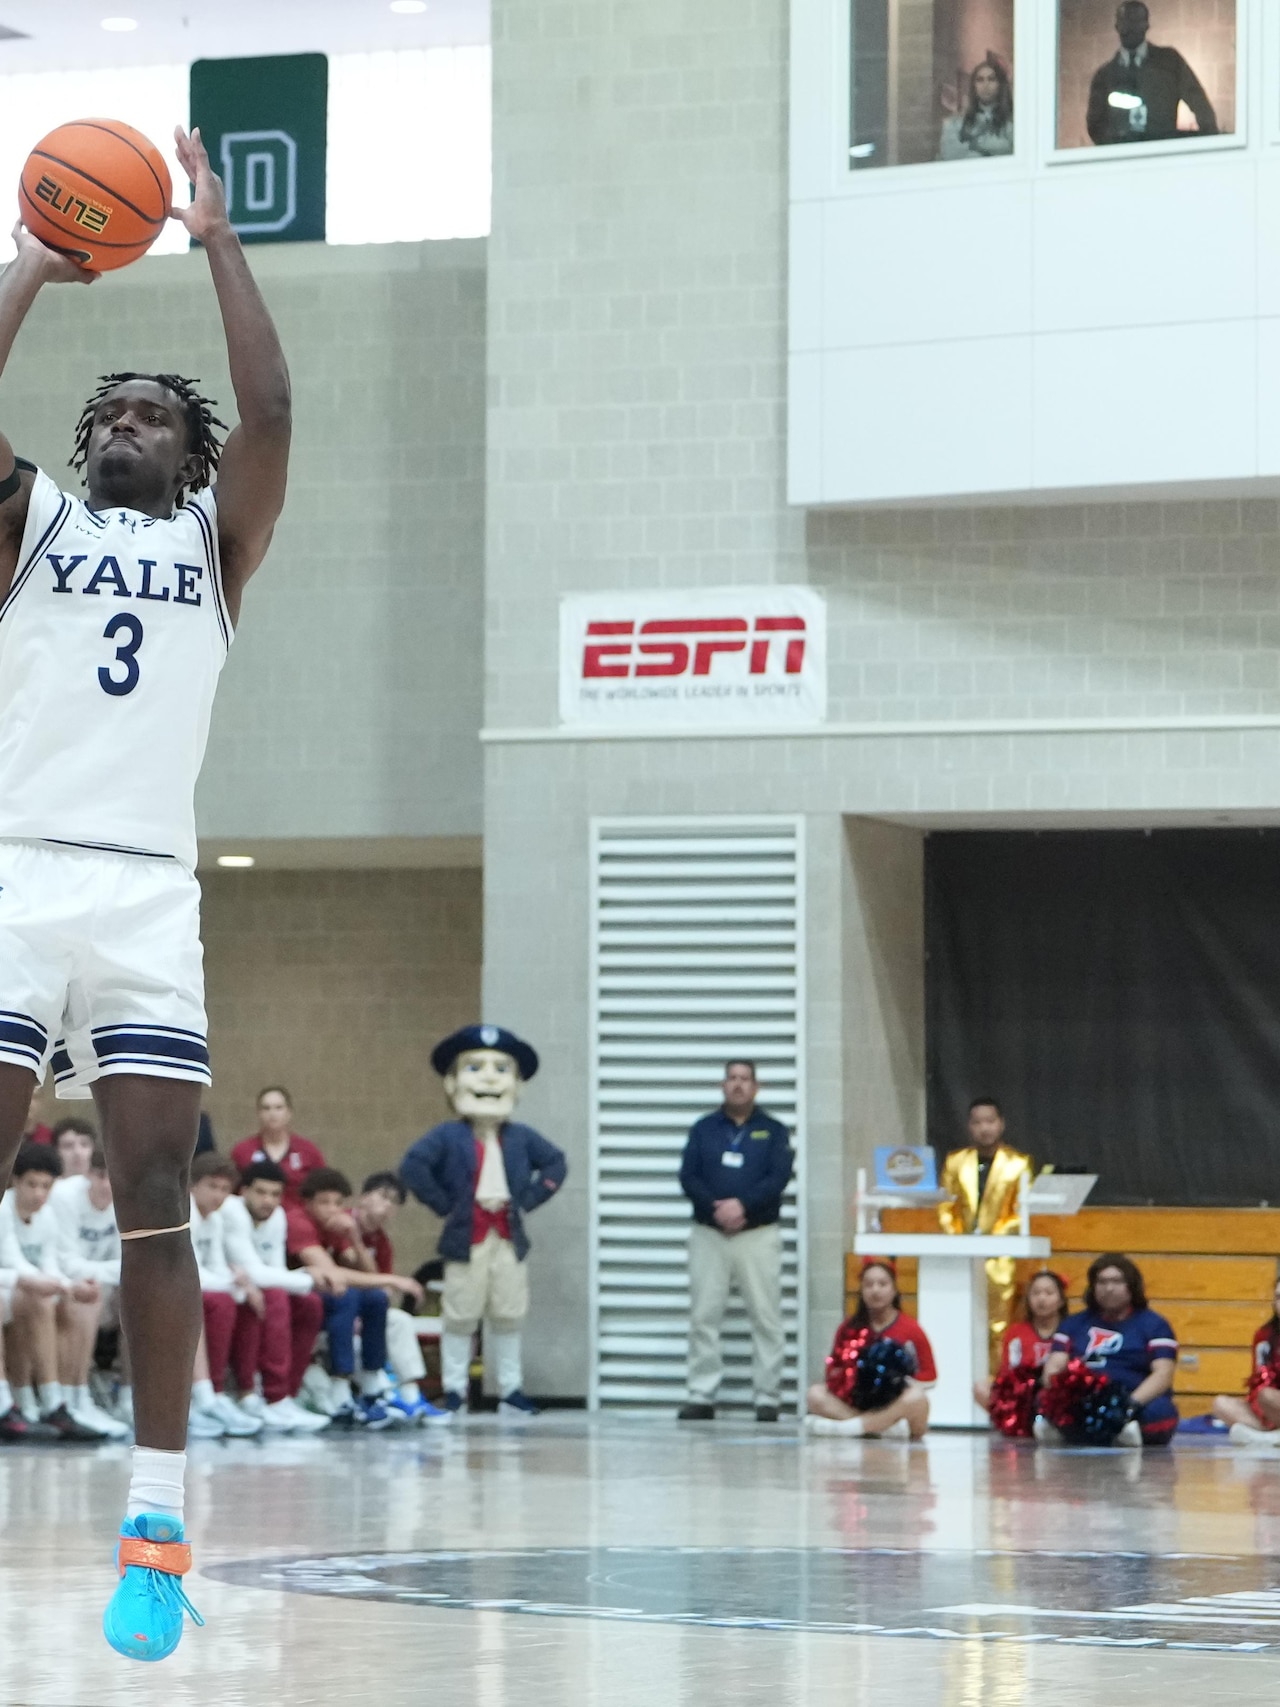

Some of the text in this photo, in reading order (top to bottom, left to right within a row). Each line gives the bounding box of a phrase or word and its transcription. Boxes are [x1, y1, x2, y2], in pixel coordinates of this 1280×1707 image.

[34, 174, 111, 235] ELITE
[221, 131, 297, 233] D
[46, 553, 203, 607] YALE
[98, 612, 144, 697] 3
[582, 617, 807, 679] ESPN
